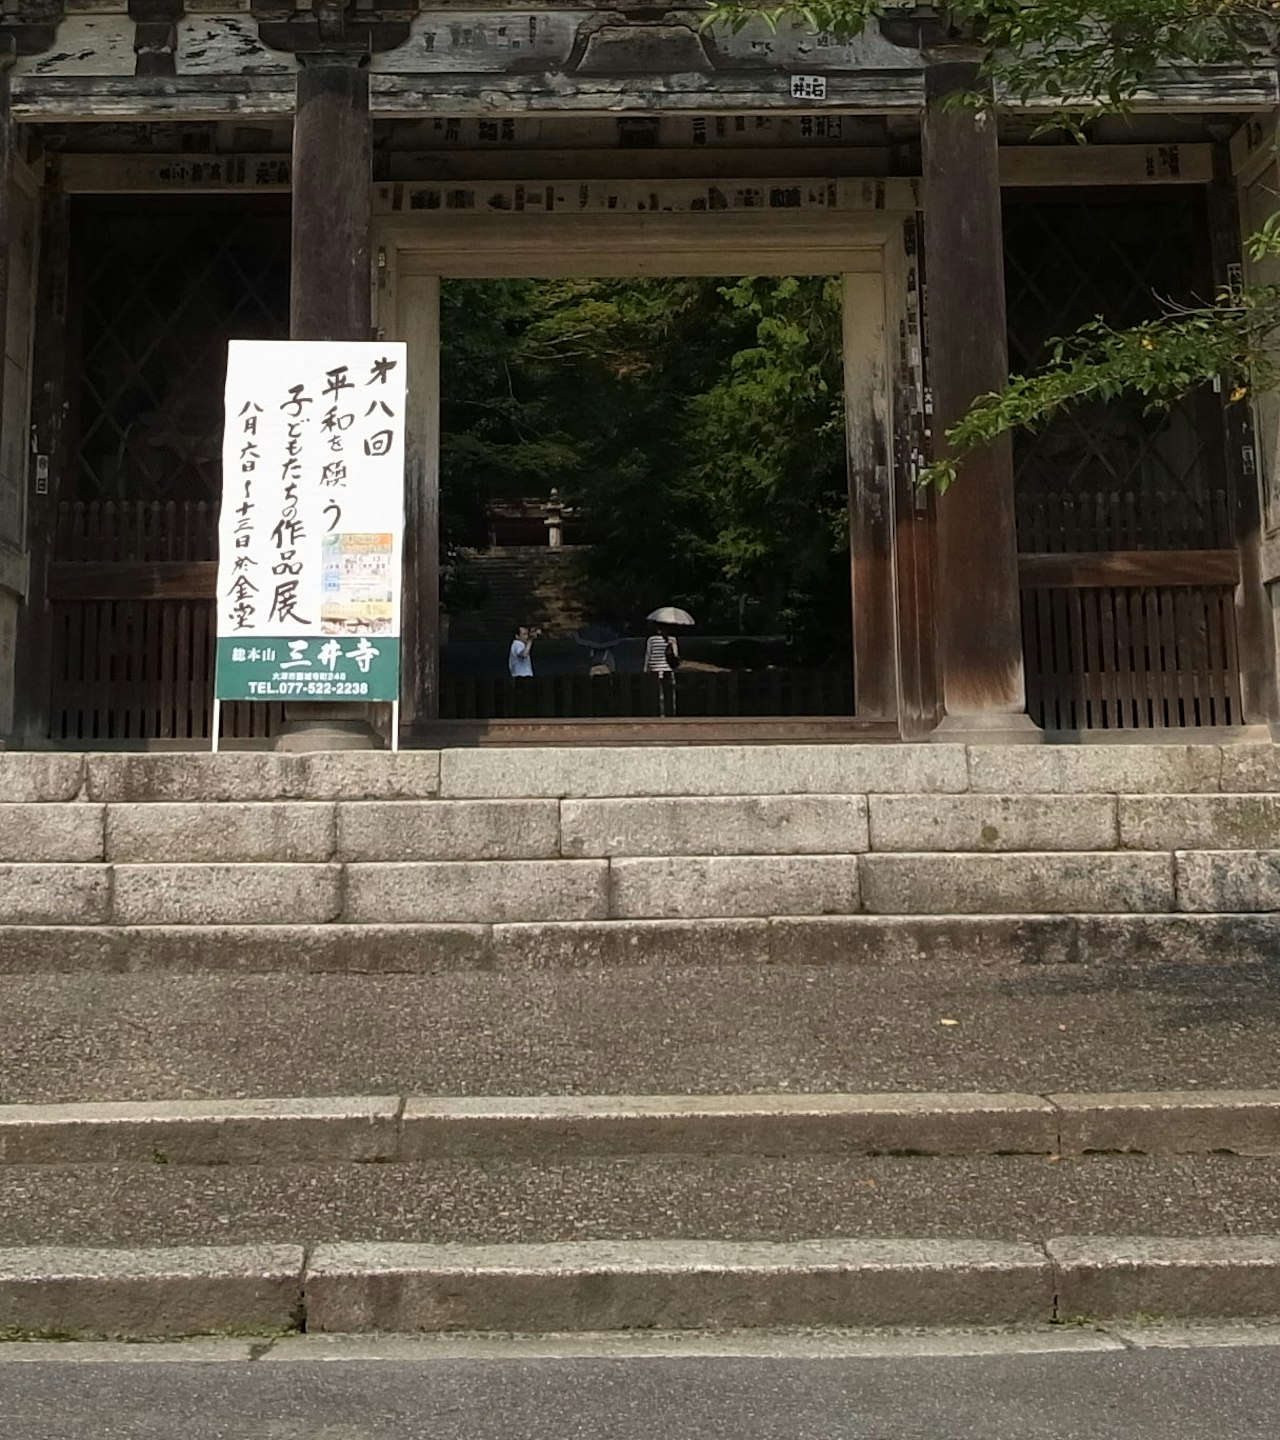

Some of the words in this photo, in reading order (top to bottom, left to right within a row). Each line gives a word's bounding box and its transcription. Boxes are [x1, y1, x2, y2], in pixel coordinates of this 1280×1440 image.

[320, 365, 355, 532] 平和を願う
[268, 384, 313, 625] 子どもたちの作品展
[248, 682, 369, 695] TEL.077-522-2238
[280, 638, 380, 673] 三井寺
